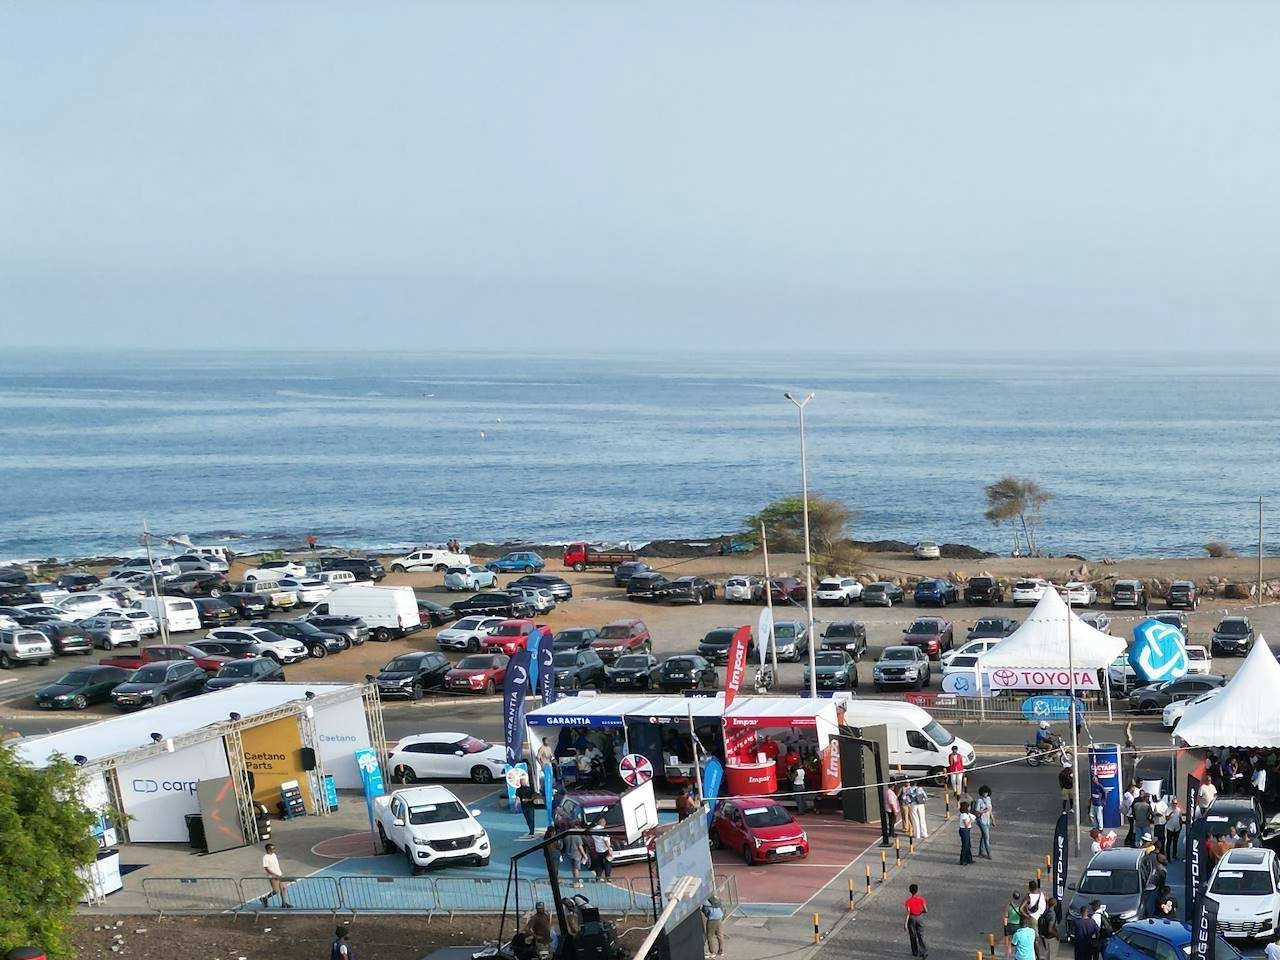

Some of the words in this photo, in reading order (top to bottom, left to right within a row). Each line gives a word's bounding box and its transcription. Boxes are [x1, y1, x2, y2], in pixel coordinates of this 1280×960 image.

[729, 641, 745, 690] Impar
[1021, 671, 1093, 685] TOYOTA
[507, 692, 518, 743] GARANTIA
[546, 717, 591, 725] GARANTIA
[733, 718, 759, 726] Impar
[319, 734, 357, 743] Caetano
[244, 752, 286, 762] Caetano
[826, 739, 839, 777] Impa
[246, 762, 273, 770] Parts
[748, 775, 771, 783] Impar
[1056, 836, 1065, 900] ETOUR
